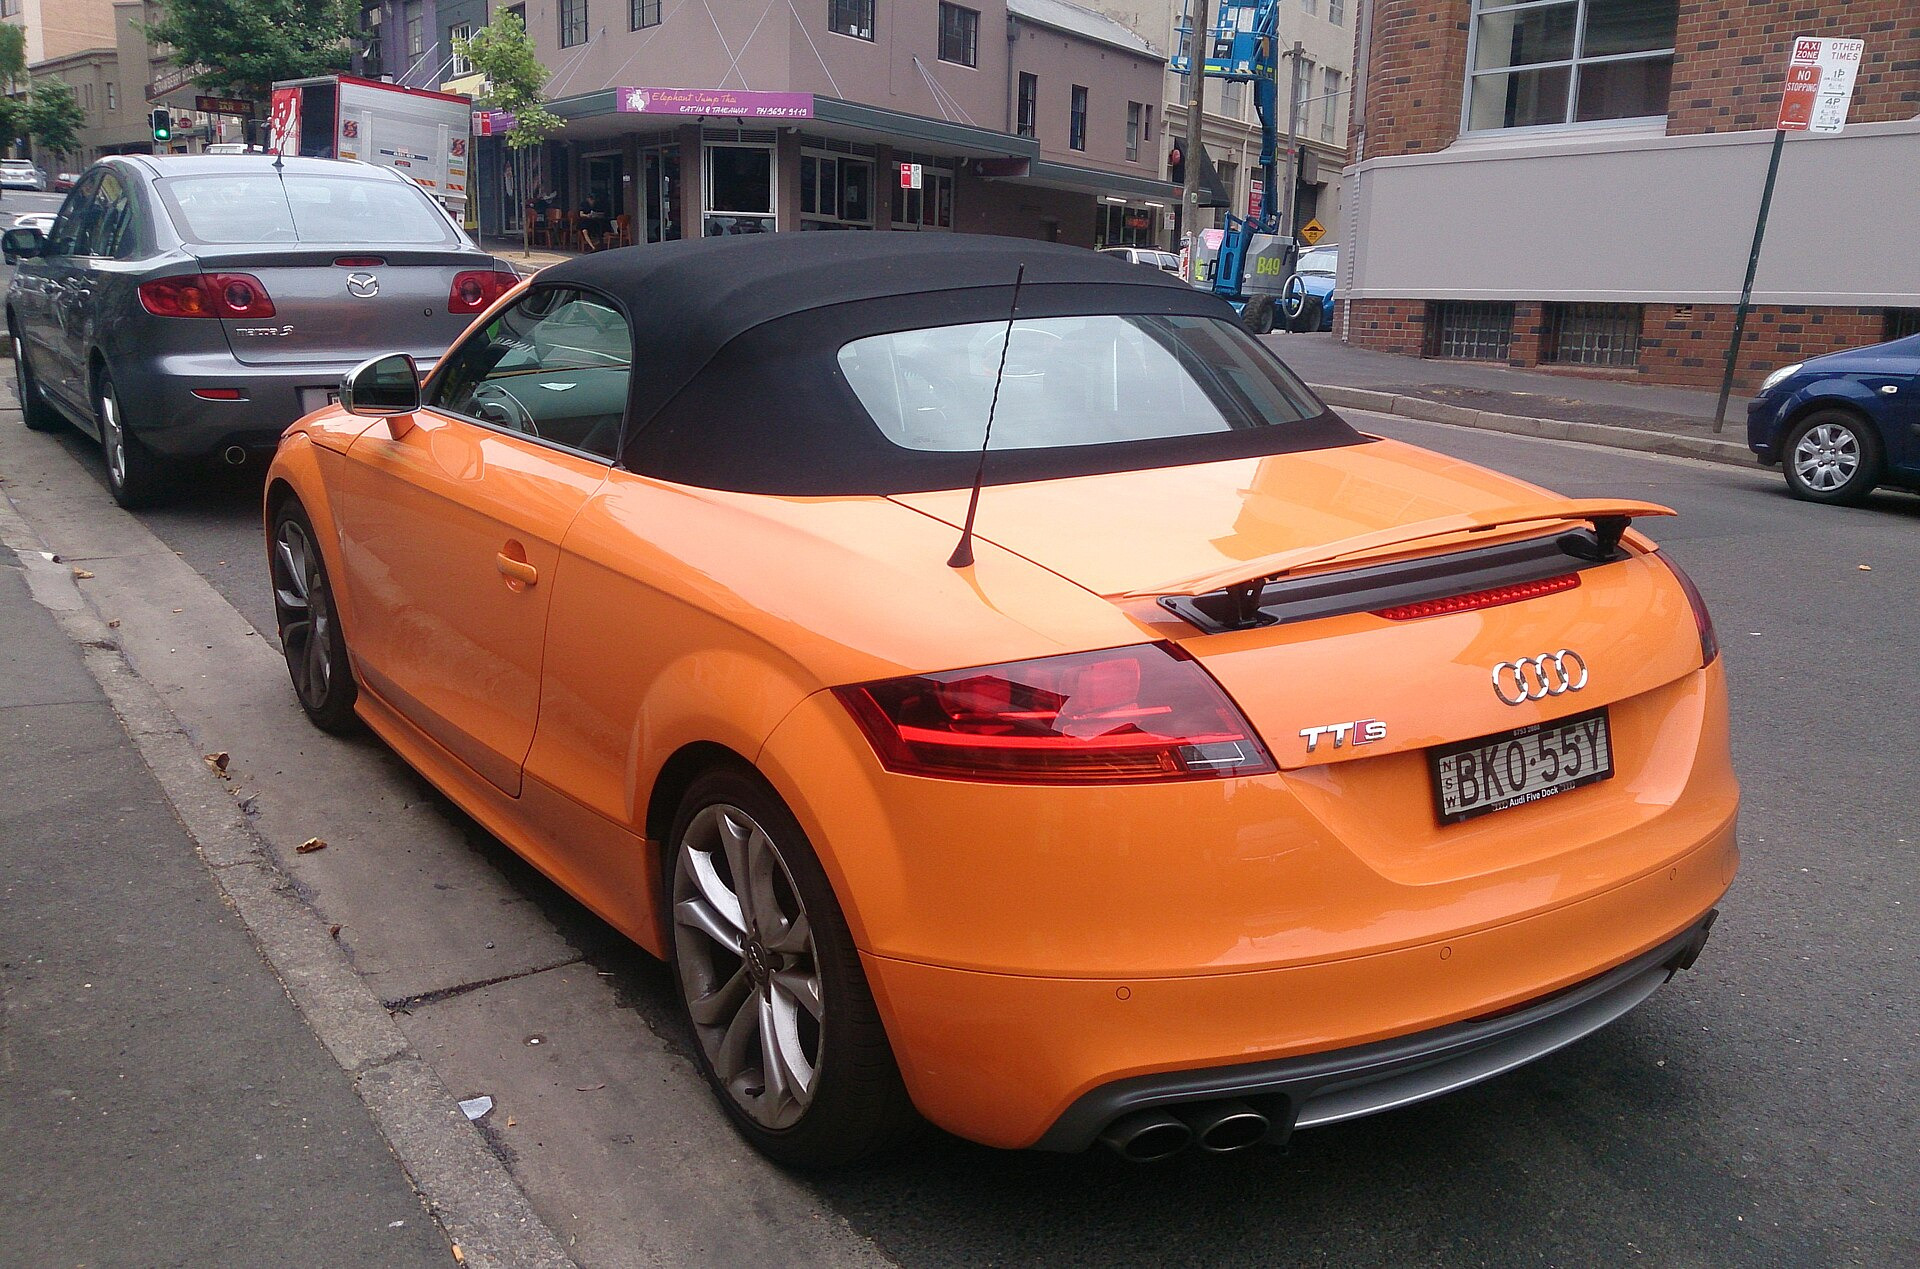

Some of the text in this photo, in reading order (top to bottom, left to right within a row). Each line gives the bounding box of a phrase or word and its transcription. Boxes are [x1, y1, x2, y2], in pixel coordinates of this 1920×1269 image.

[1799, 41, 1820, 51] TAXI
[1832, 42, 1862, 52] OTHER
[1796, 50, 1818, 59] ZONE
[1832, 52, 1858, 61] TIMES
[1797, 70, 1811, 81] NO
[1786, 82, 1818, 92] STOPPING
[652, 91, 693, 106] Elephant
[695, 93, 719, 107] Jump
[1825, 98, 1841, 106] 4P
[711, 106, 749, 114] TAKEAWAY
[1257, 257, 1280, 275] B49
[1509, 786, 1559, 807] Audi Five Dock
